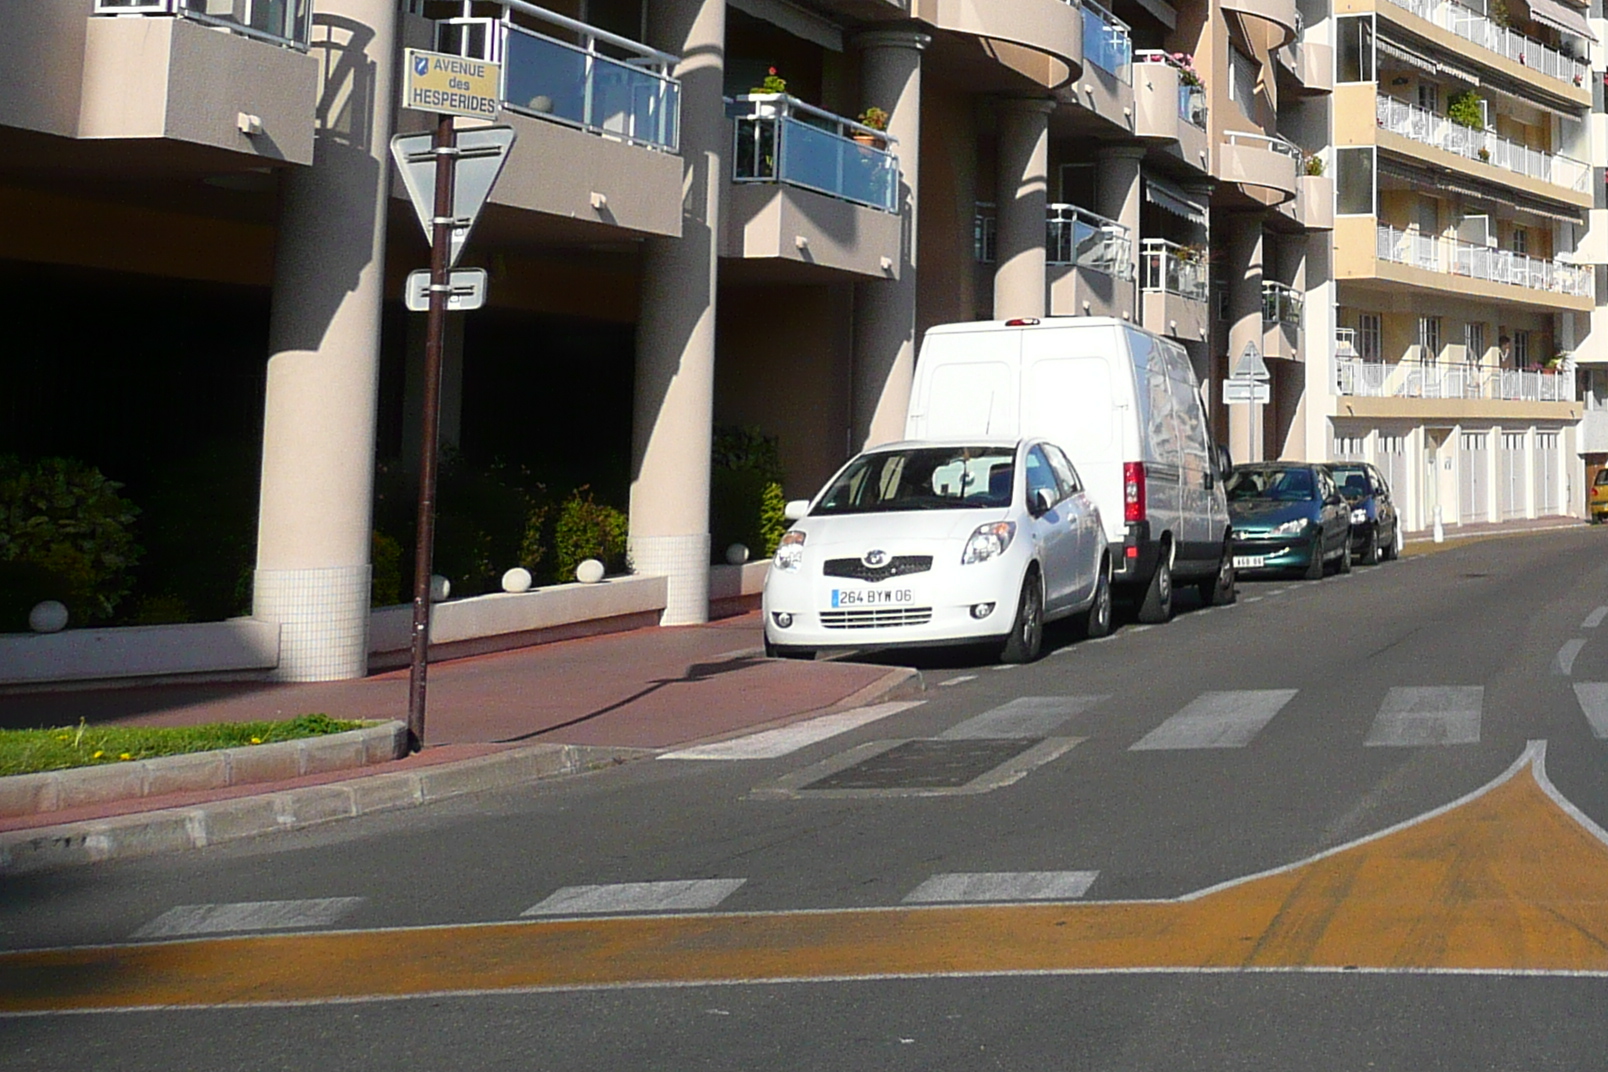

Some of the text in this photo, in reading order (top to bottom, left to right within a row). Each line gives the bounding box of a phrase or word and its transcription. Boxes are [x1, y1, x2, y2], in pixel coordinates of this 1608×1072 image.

[434, 59, 485, 78] AVENUE
[449, 77, 470, 91] des
[413, 88, 495, 114] HESPERIDES
[840, 589, 912, 604] 264 BYW 06
